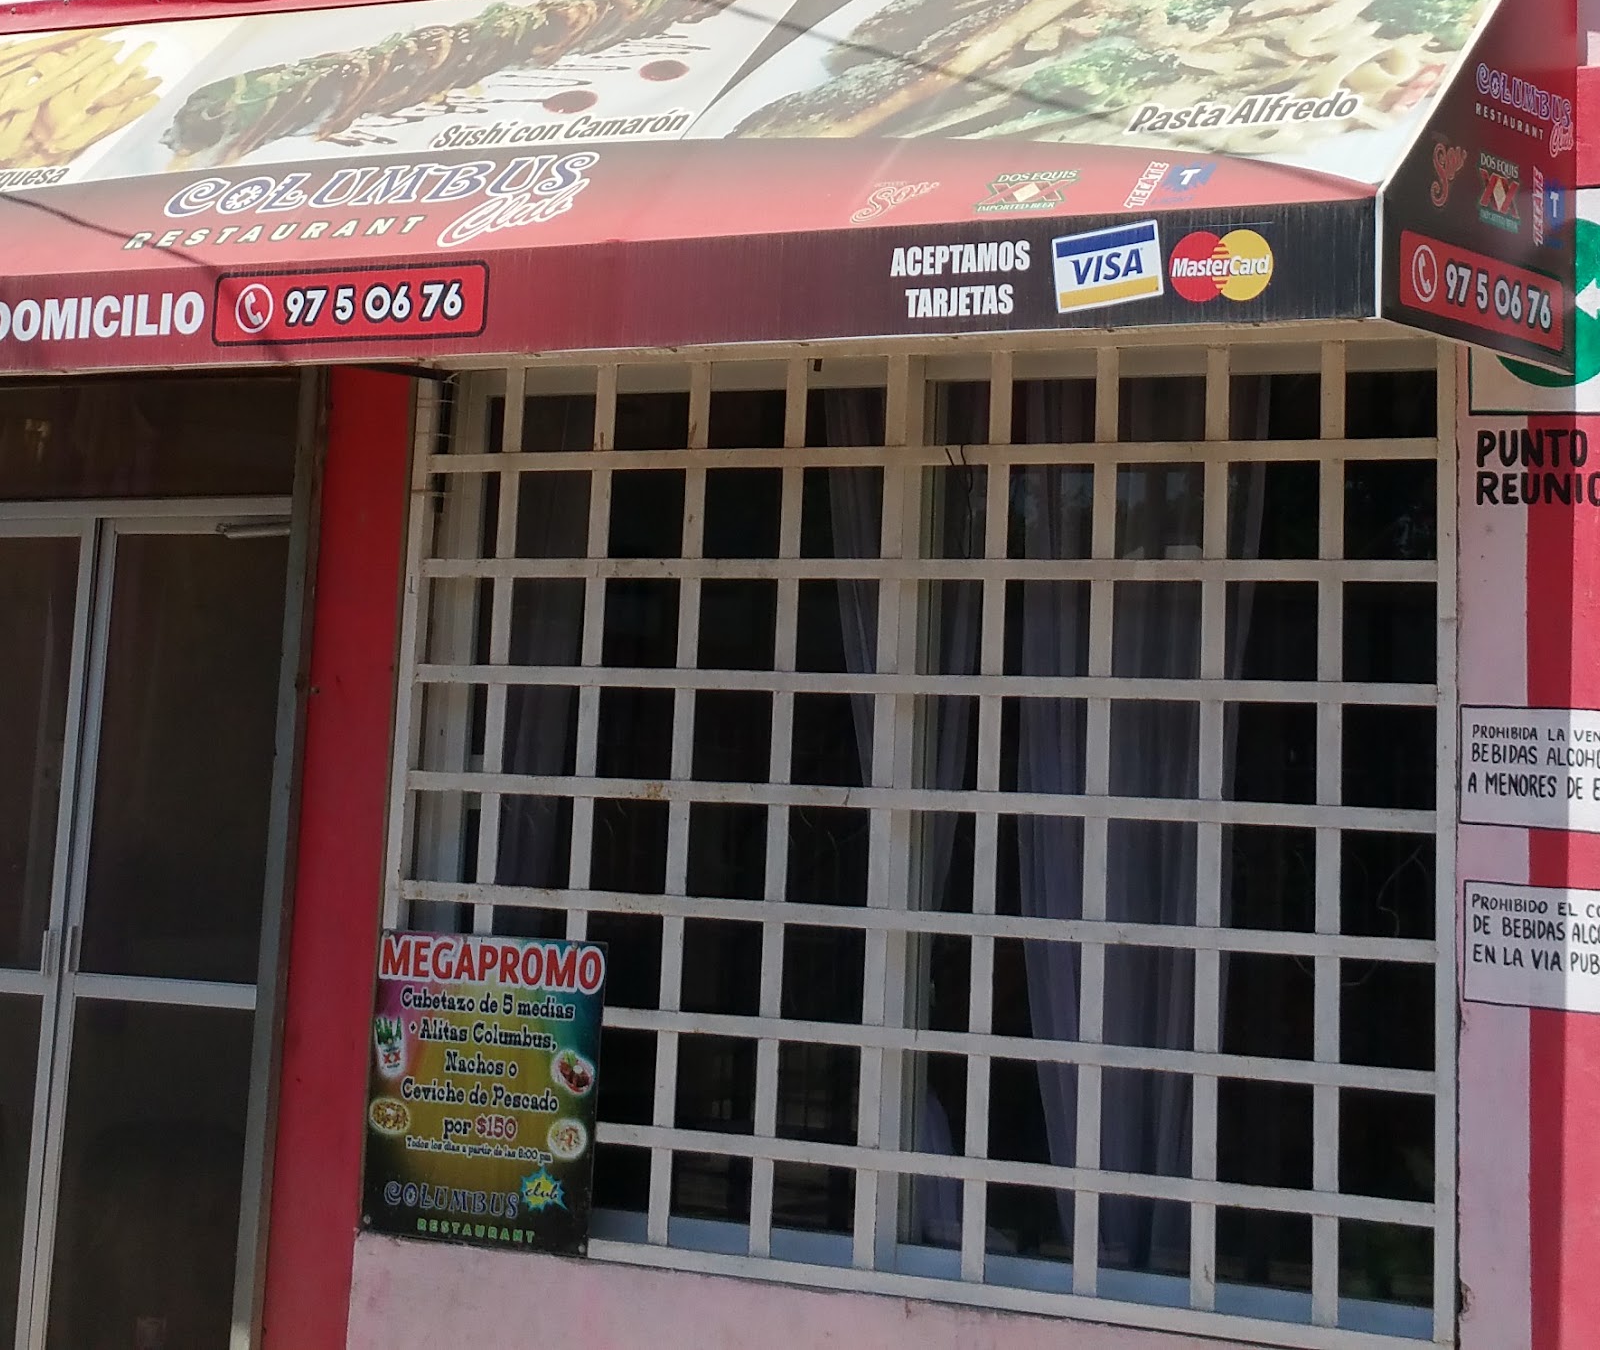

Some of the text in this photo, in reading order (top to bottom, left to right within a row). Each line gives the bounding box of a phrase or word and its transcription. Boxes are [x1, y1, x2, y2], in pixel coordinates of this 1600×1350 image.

[1129, 90, 1361, 133] Pasta Alfredo
[1476, 62, 1572, 129] COLUMBUS
[433, 109, 691, 150] Sushi con Camarón
[1475, 102, 1544, 141] RESTAURANT
[998, 170, 1079, 183] DOS EQUIS
[1480, 152, 1519, 180] DOS EQUIS
[163, 152, 601, 219] COLUMBUS
[1124, 161, 1169, 208] TECATE
[123, 175, 590, 252] RESTAURANT Club
[890, 239, 1270, 286] ACEPTAMOS VISA MasterCard
[285, 287, 324, 325] 97
[334, 287, 355, 321] 5
[364, 283, 411, 320] 06
[420, 281, 464, 319] 76
[905, 284, 1014, 319] TARJETAS
[1445, 262, 1552, 330] 97 5 06 76
[1476, 428, 1588, 470] PUNTO
[1472, 724, 1539, 742] PROHIBIDA
[1547, 727, 1565, 742] LA
[1471, 743, 1538, 765] BEBIDAS
[1467, 776, 1477, 794] A
[1485, 772, 1557, 799] MENORES
[1567, 776, 1584, 800] DE
[1471, 893, 1548, 915] PROHIBIDO
[1558, 902, 1578, 917] EL
[1473, 914, 1491, 936] DE
[1502, 917, 1566, 942] BEBIDAS
[381, 938, 603, 990] MEGAPROMO
[1472, 943, 1496, 965] EN
[1503, 945, 1525, 967] LA
[1531, 949, 1563, 972] VIA
[402, 987, 574, 1019] Cubetazo de 5 medias
[420, 1018, 468, 1043] Alitas
[473, 1022, 557, 1051] Columbus,
[446, 1051, 517, 1076] Nachos o
[402, 1077, 558, 1112] Ceviche de Pescado
[443, 1114, 516, 1140] por $150
[384, 1178, 558, 1219] COLUMBUS club
[417, 1217, 536, 1244] RESTAURANT
